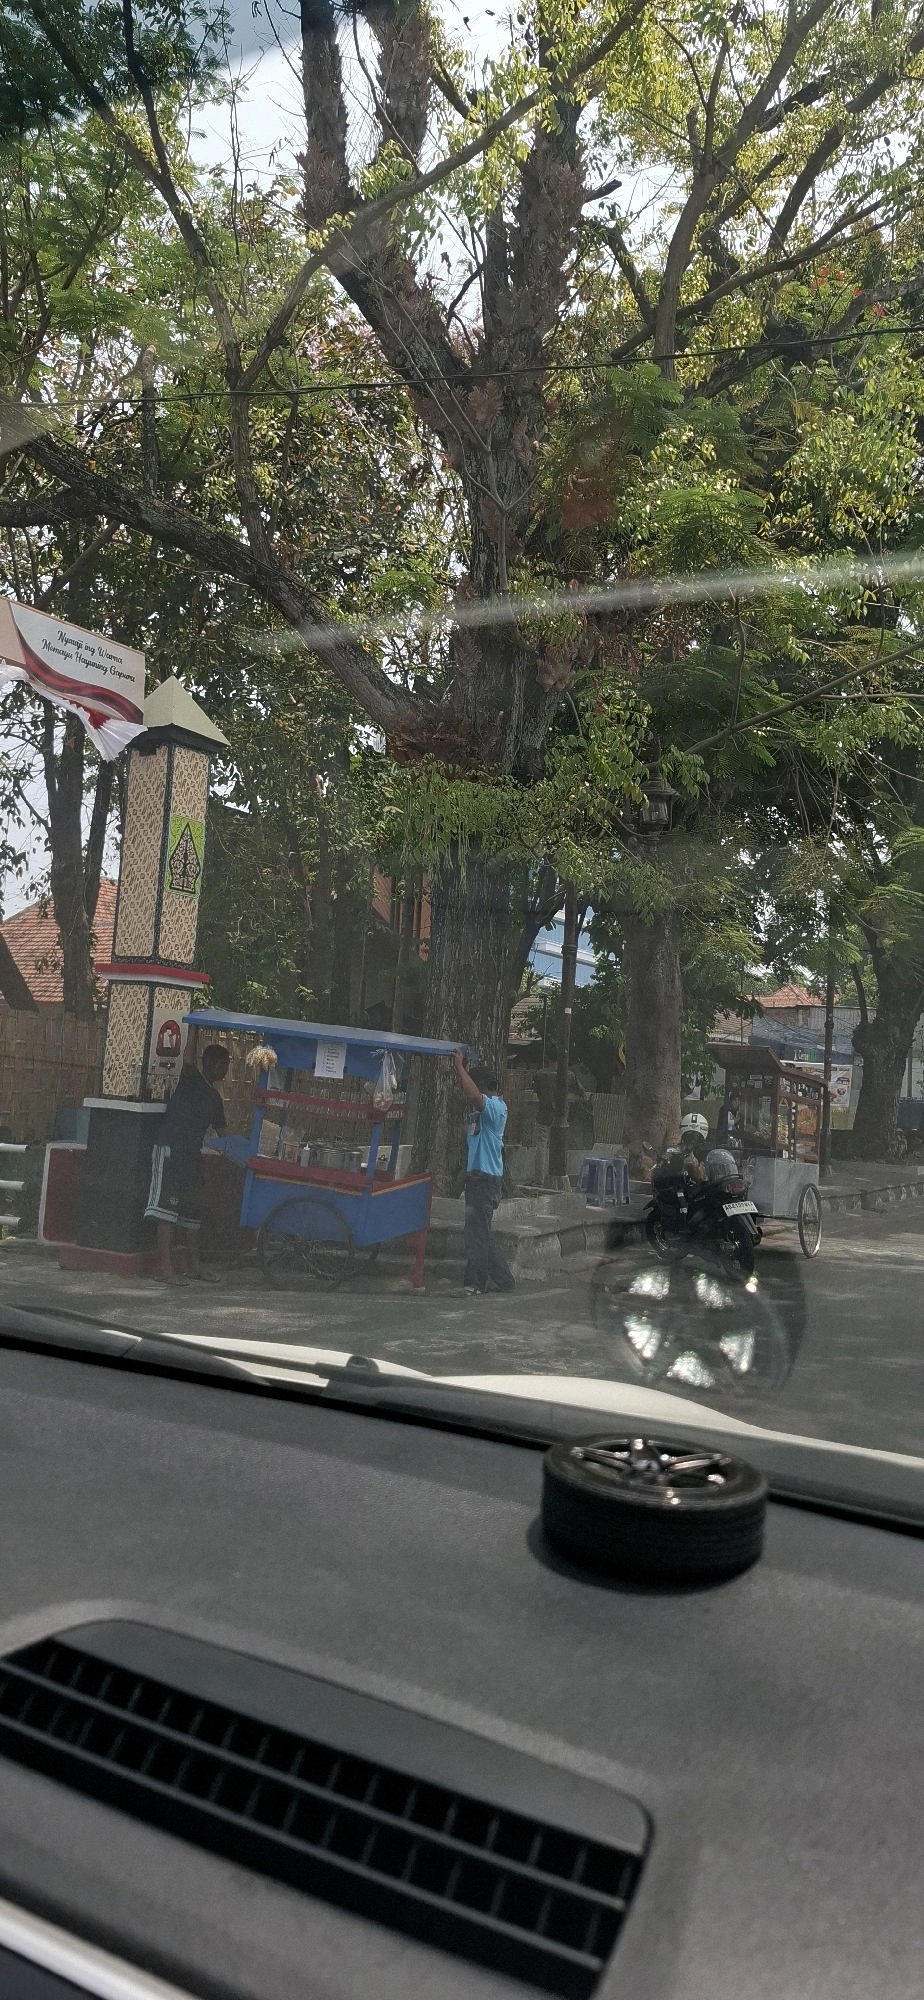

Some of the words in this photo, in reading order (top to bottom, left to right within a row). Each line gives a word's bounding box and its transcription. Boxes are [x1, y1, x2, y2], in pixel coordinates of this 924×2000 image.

[75, 651, 108, 675] Hayuning
[110, 666, 135, 682] Gapura
[85, 643, 96, 656] ing
[98, 646, 123, 664] Warna
